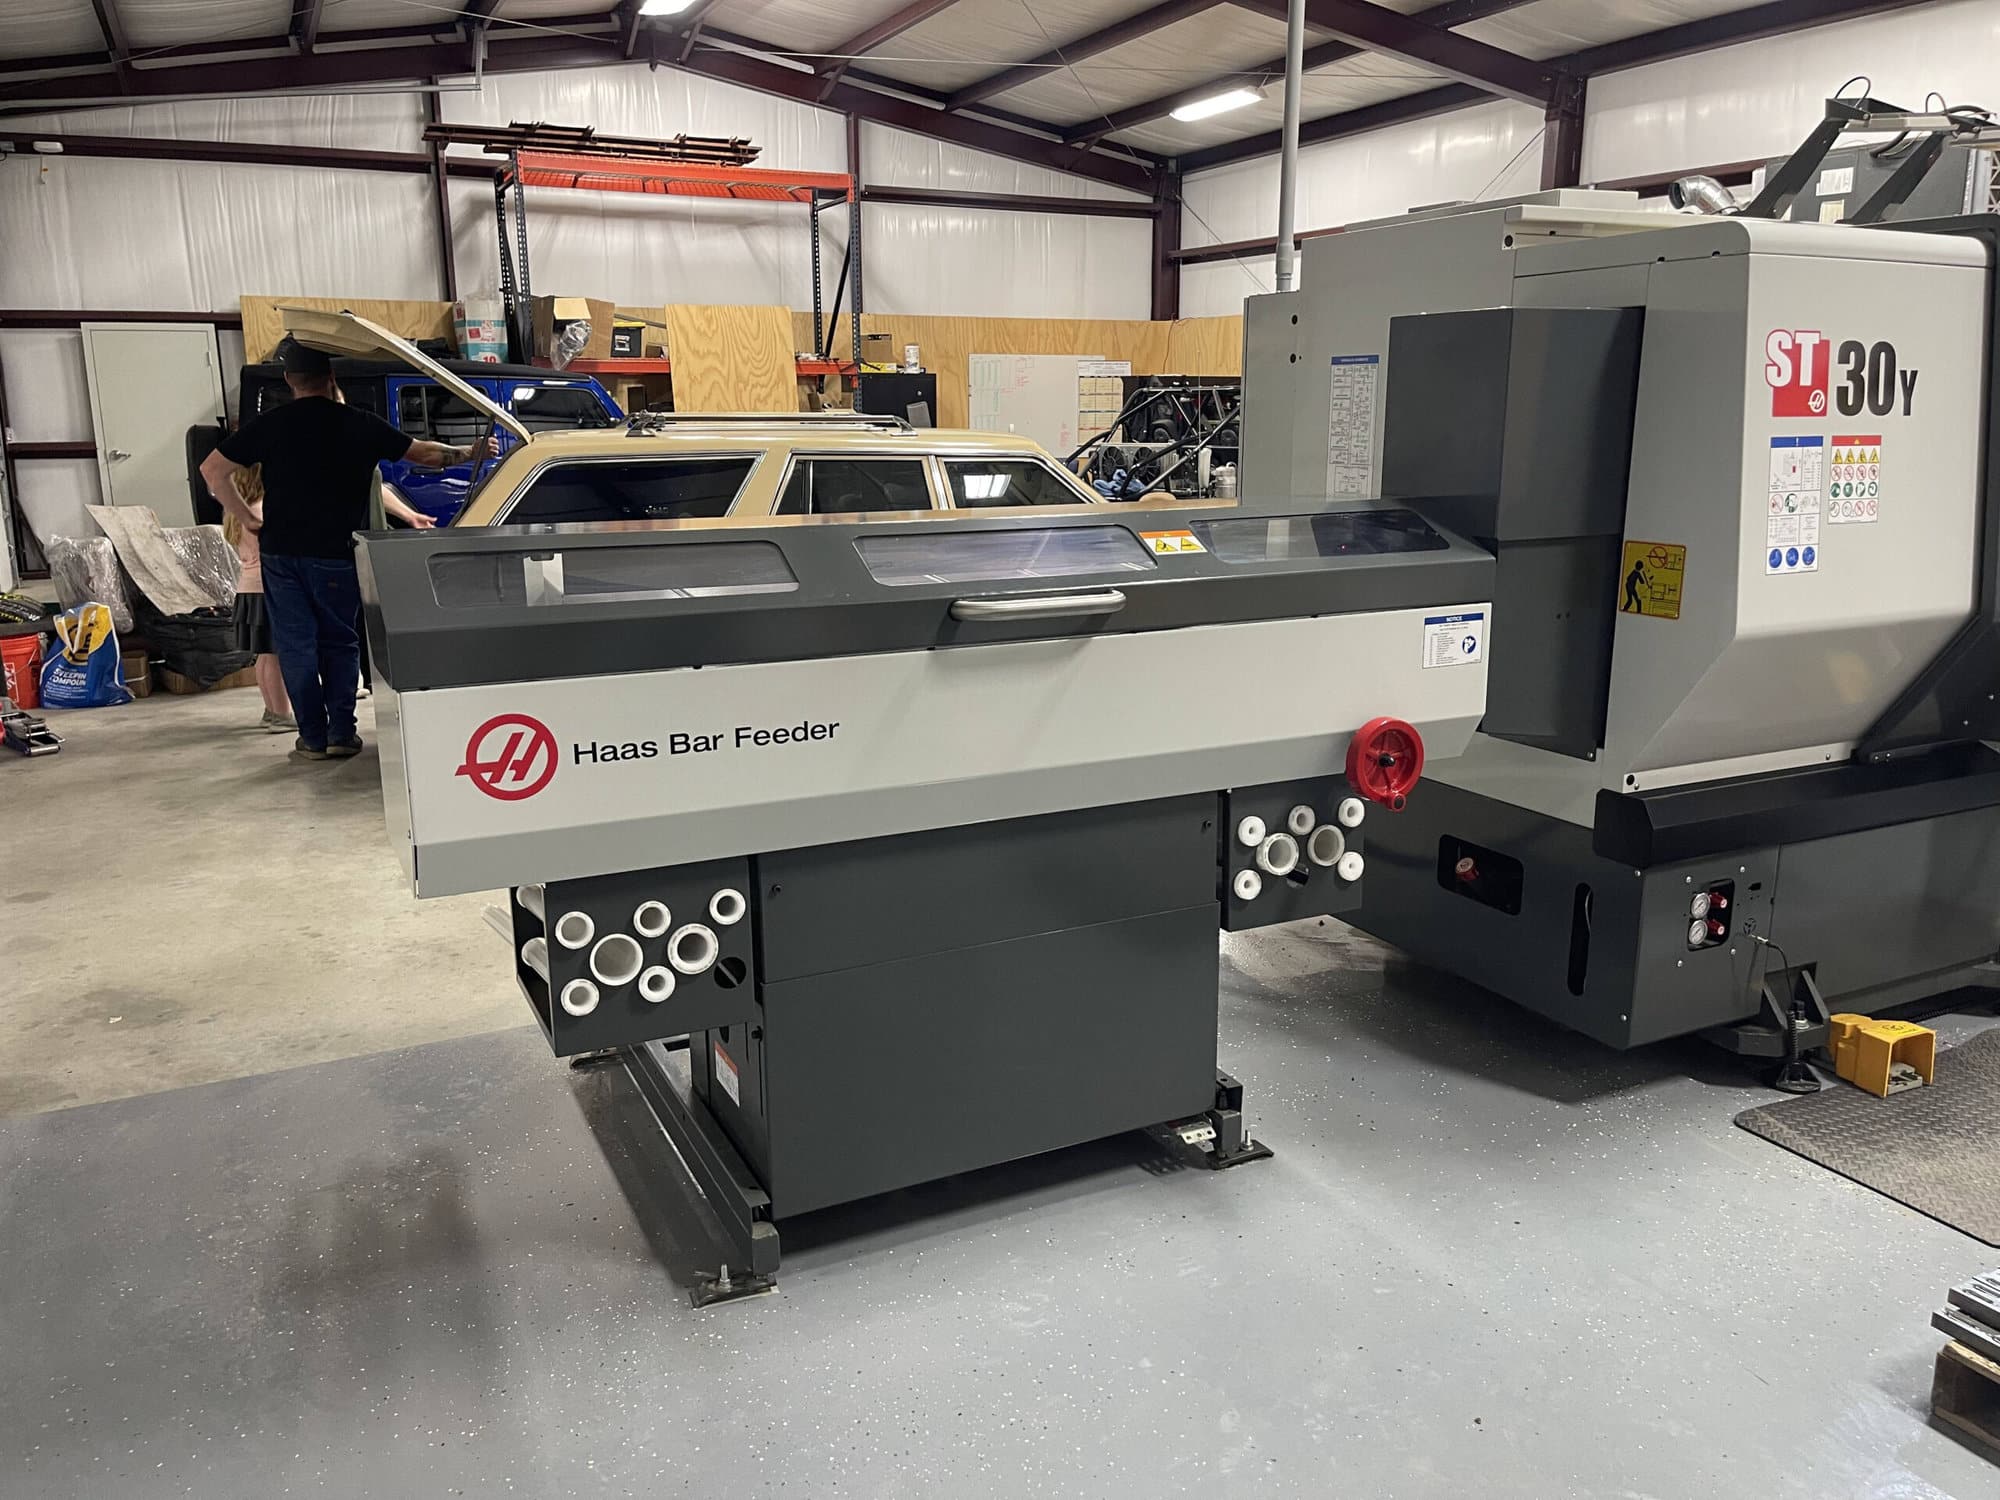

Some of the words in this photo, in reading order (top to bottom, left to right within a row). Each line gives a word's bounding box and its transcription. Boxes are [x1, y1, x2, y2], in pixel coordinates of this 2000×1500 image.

[1765, 329, 1821, 387] ST
[49, 675, 87, 686] COMPOUN
[573, 739, 659, 766] Haas
[669, 732, 724, 757] Bar
[734, 721, 841, 750] Feeder
